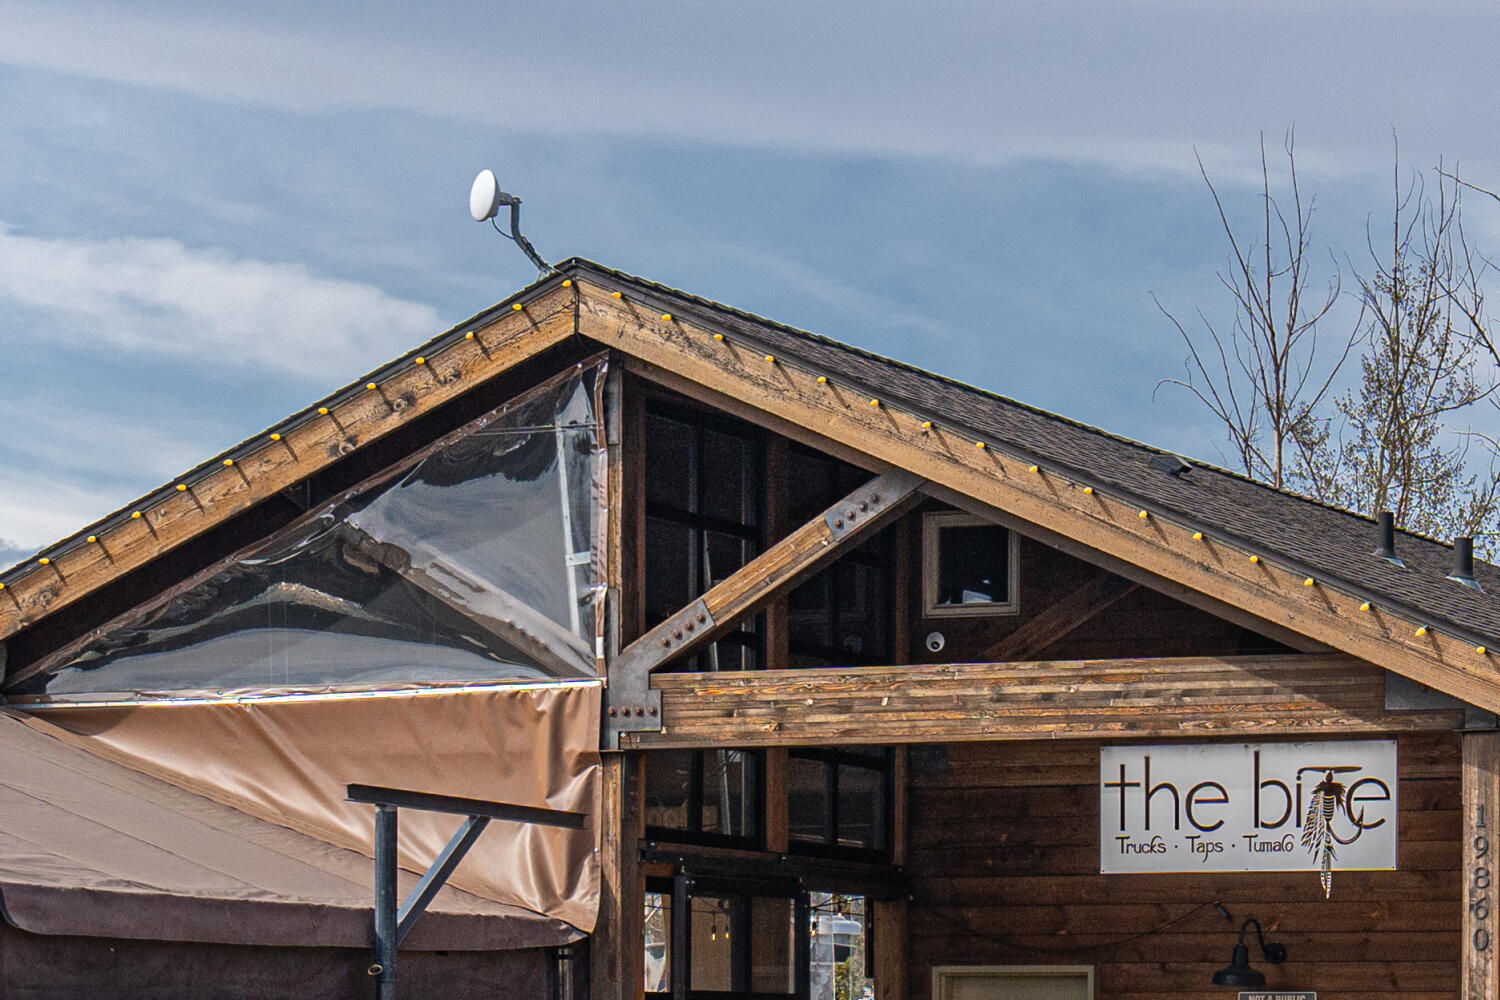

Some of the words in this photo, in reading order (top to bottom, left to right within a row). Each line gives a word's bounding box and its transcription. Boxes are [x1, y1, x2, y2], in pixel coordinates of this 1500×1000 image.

[1104, 754, 1229, 832] the
[1254, 750, 1391, 831] bite
[1115, 835, 1167, 855] Trucks
[1185, 834, 1224, 863] Taps
[1242, 833, 1294, 853] Tumalo
[1472, 804, 1491, 952] 19860
